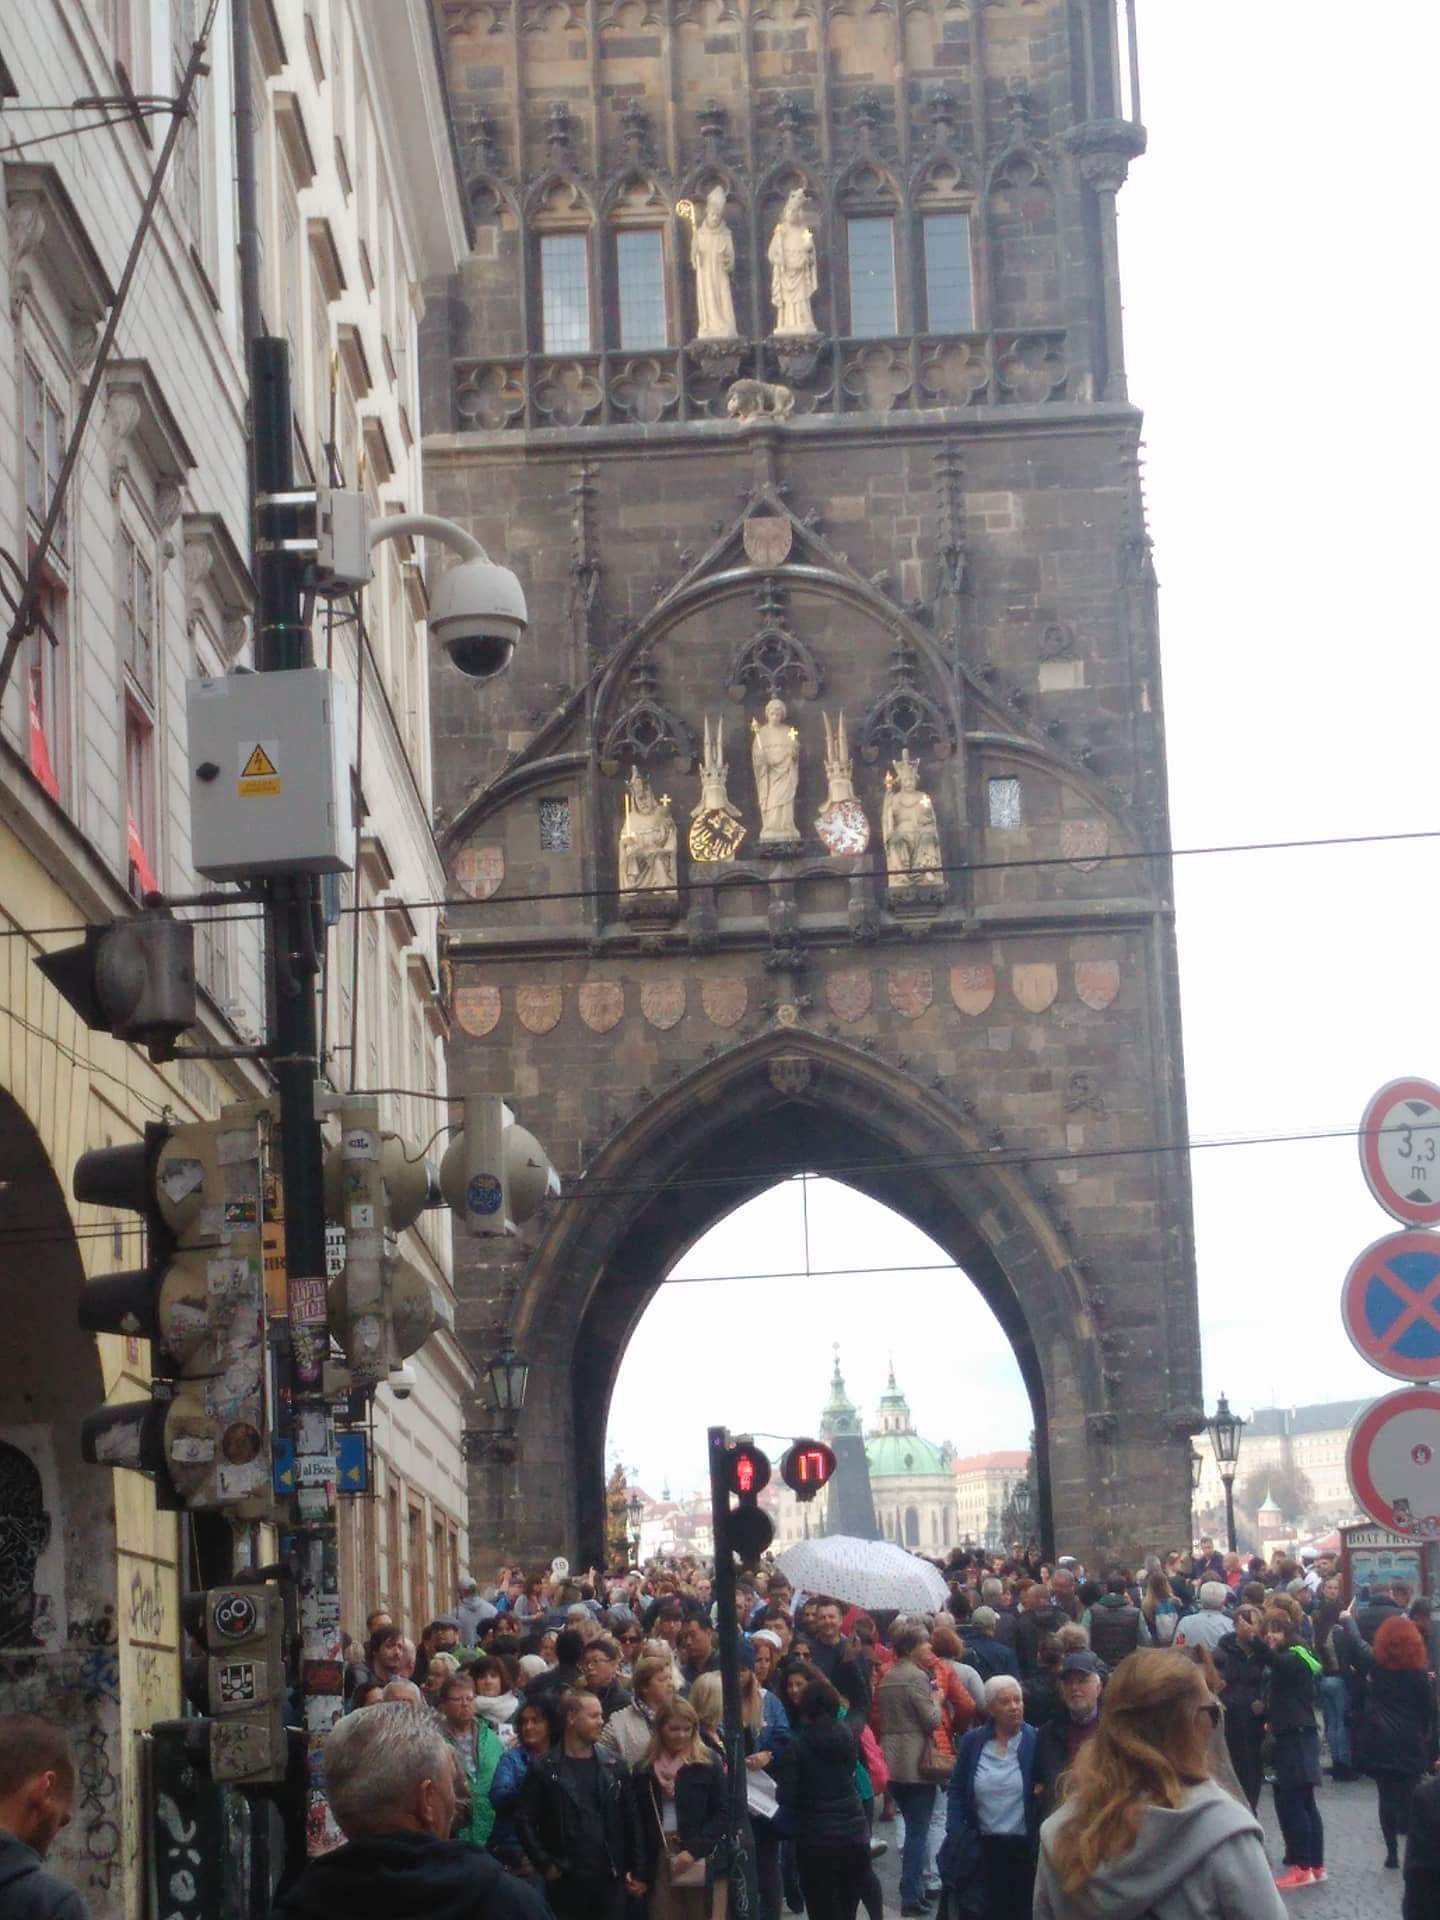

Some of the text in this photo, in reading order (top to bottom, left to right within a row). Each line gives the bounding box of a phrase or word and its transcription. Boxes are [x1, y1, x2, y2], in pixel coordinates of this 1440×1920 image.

[1398, 1122, 1436, 1162] 3,3
[1411, 1165, 1426, 1180] m
[799, 1452, 823, 1481] 17
